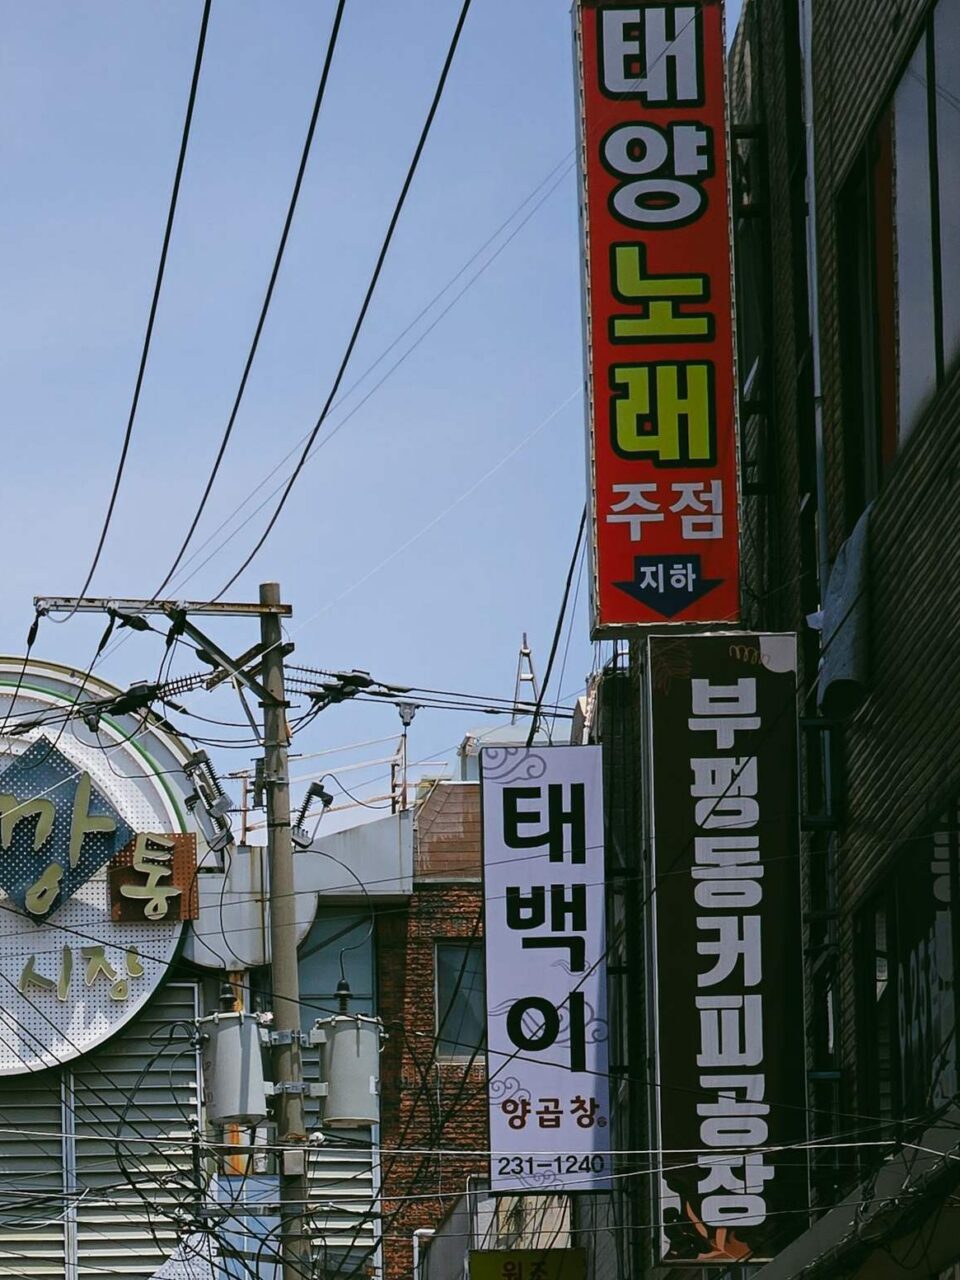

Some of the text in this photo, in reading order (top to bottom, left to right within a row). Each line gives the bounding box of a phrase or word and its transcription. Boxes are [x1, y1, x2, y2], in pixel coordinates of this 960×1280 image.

[602, 7, 711, 461] 태양 노래
[606, 479, 724, 541] 주점
[640, 563, 696, 593] 지하
[501, 782, 588, 1074] 태백이
[688, 677, 775, 1228] 부평동커피공장
[18, 943, 144, 1001] 시장
[501, 1094, 600, 1131] 양곱창
[497, 1154, 605, 1176] 231-1240
